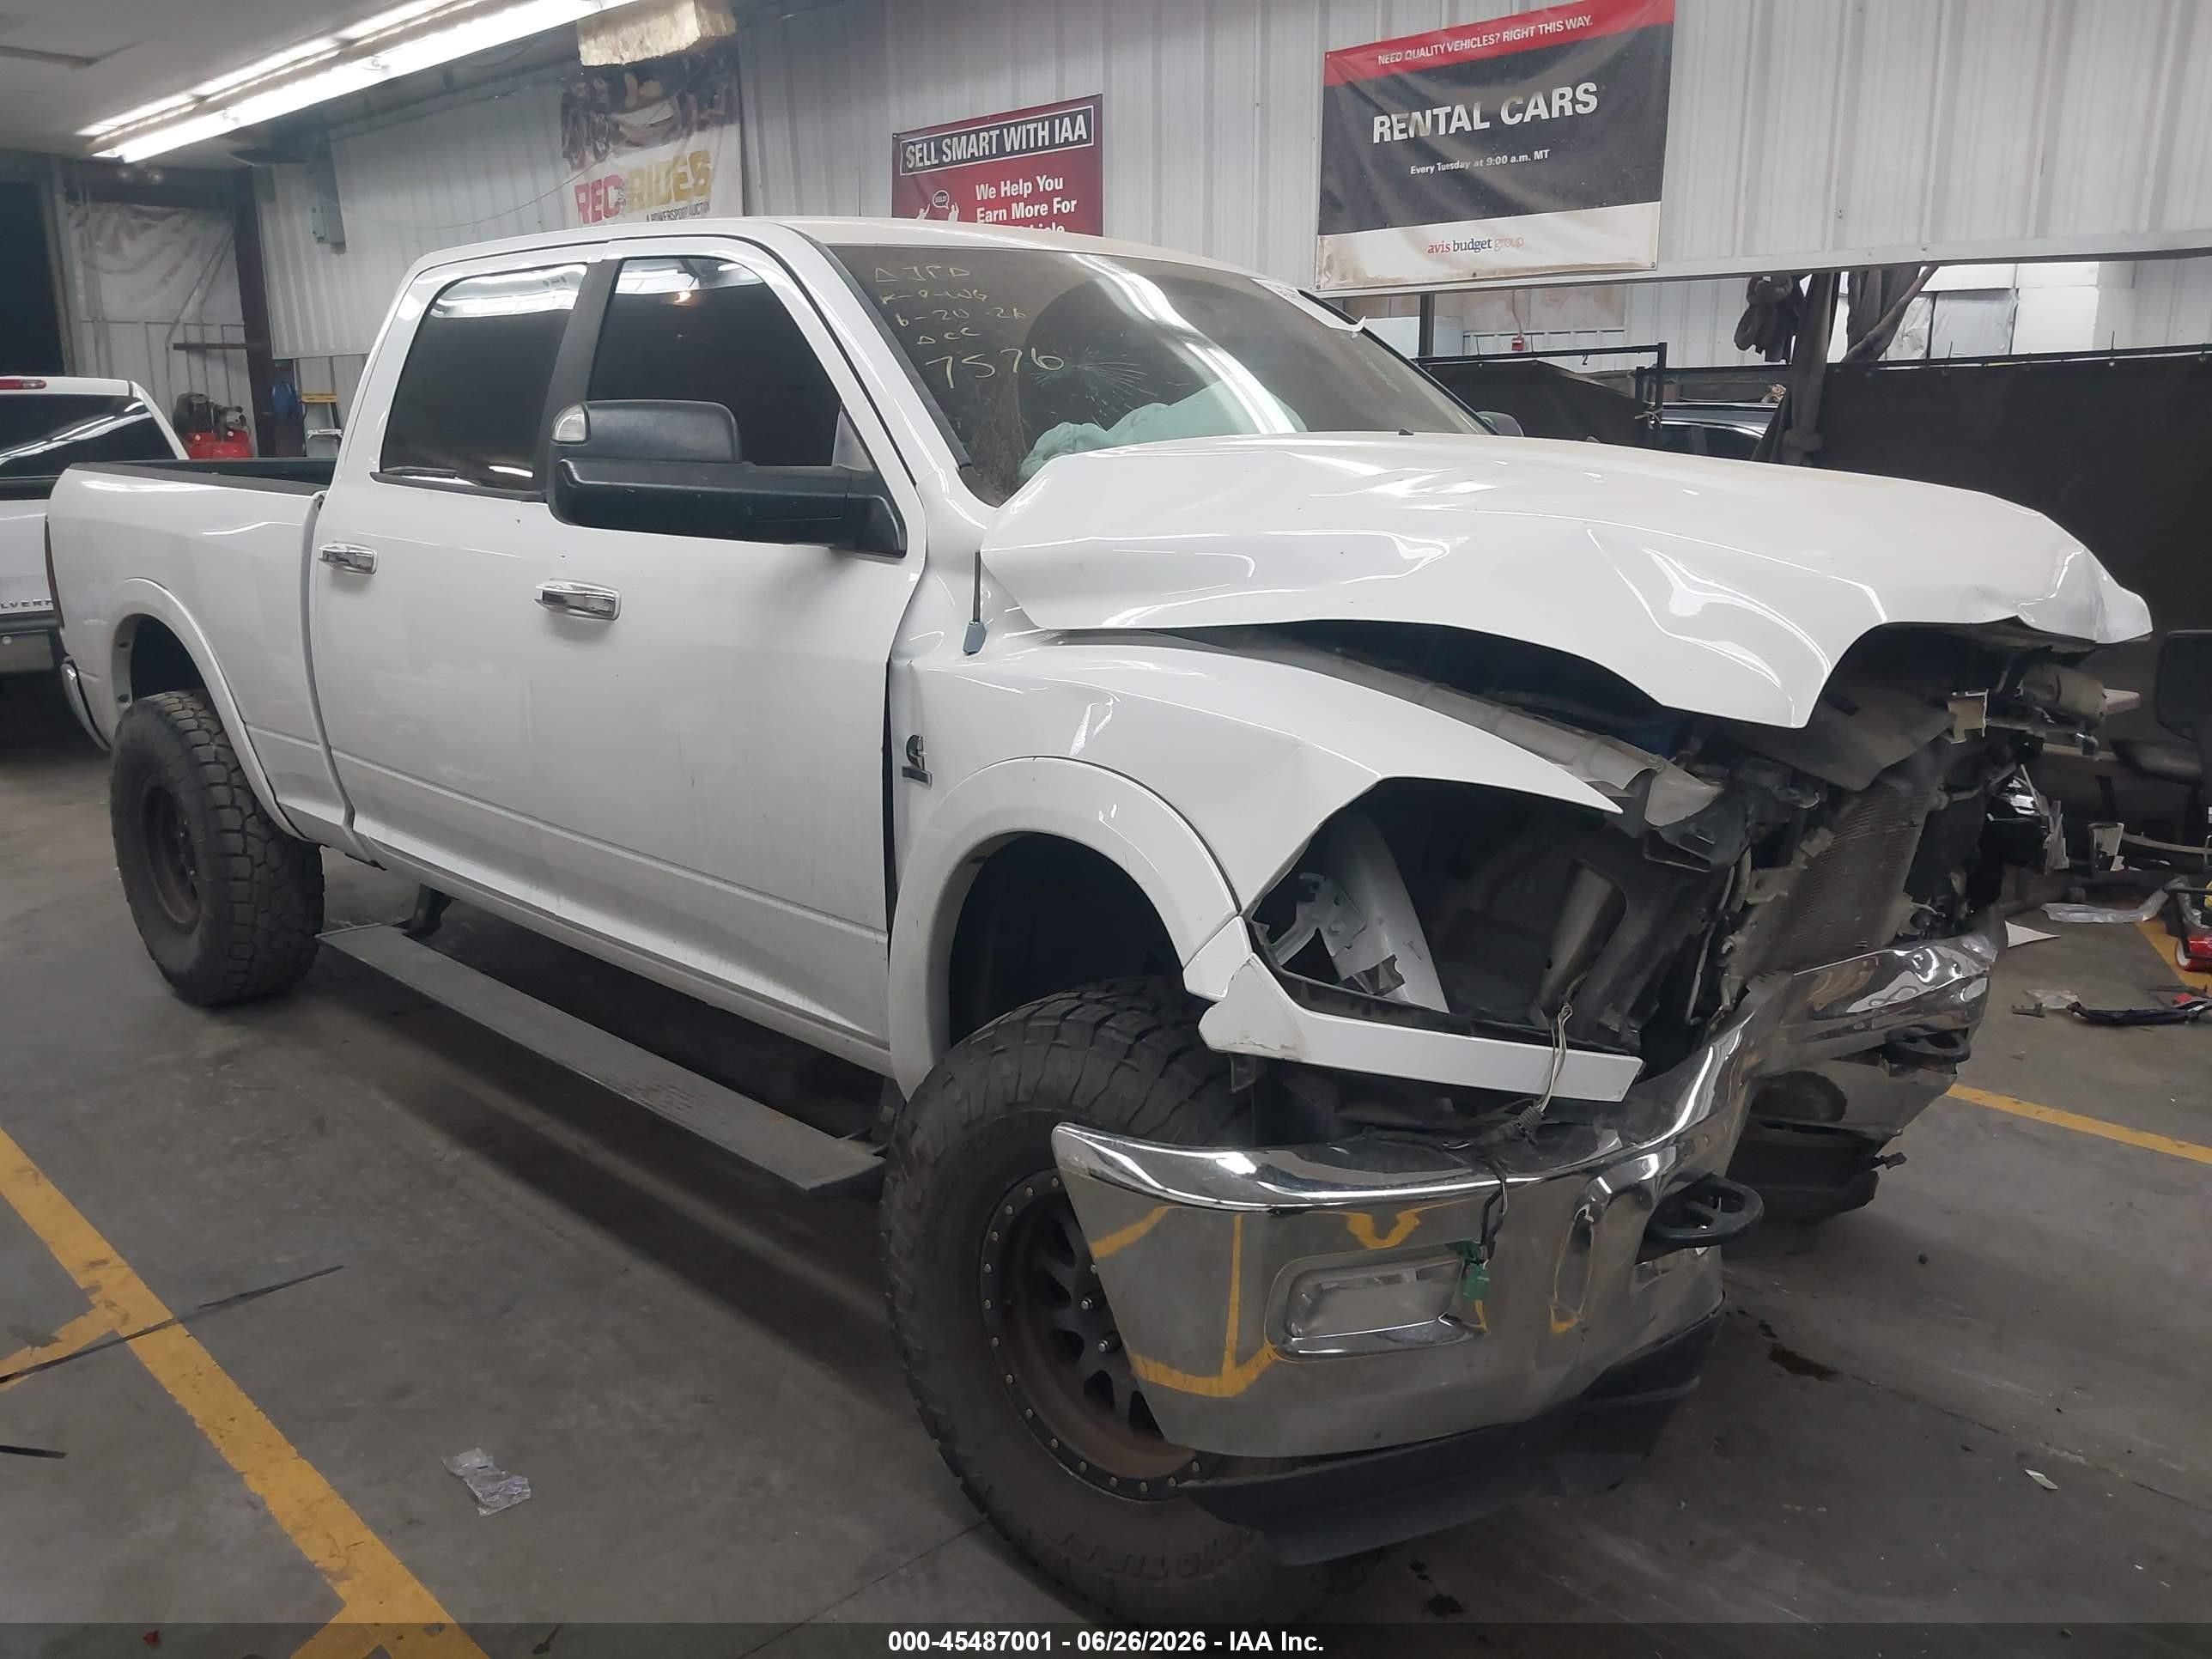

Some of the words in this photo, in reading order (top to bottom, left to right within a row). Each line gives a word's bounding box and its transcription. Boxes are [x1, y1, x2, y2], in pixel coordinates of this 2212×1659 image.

[1377, 52, 1401, 65] NEED
[1405, 43, 1446, 60] QUALITY
[1447, 33, 1500, 52] VEHICLES?
[1503, 26, 1536, 42] RIGHT
[1538, 21, 1564, 35] THIS
[1565, 15, 1593, 29] WAY.
[1373, 101, 1490, 143] RENTAL
[1500, 82, 1598, 125] CARS
[906, 141, 939, 168] SELL
[942, 130, 1000, 163] SMART
[1003, 120, 1049, 152] WITH
[1054, 114, 1087, 144] IAA
[1410, 165, 1435, 175] Every
[1437, 161, 1471, 172] Tuesday
[1486, 155, 1508, 166] 9:00
[1510, 155, 1531, 163] a.m.
[1534, 149, 1551, 161] MT
[574, 174, 621, 225] REC
[626, 150, 712, 214] RIDES
[975, 183, 996, 201] We
[1000, 178, 1032, 198] Help
[1036, 174, 1064, 192] You
[976, 207, 1007, 223] Earn
[1012, 202, 1048, 220] More
[1053, 197, 1077, 215] For
[1427, 240, 1451, 254] avis
[1452, 237, 1492, 253] budget
[1494, 236, 1525, 252] group
[1582, 353, 1589, 366] 2
